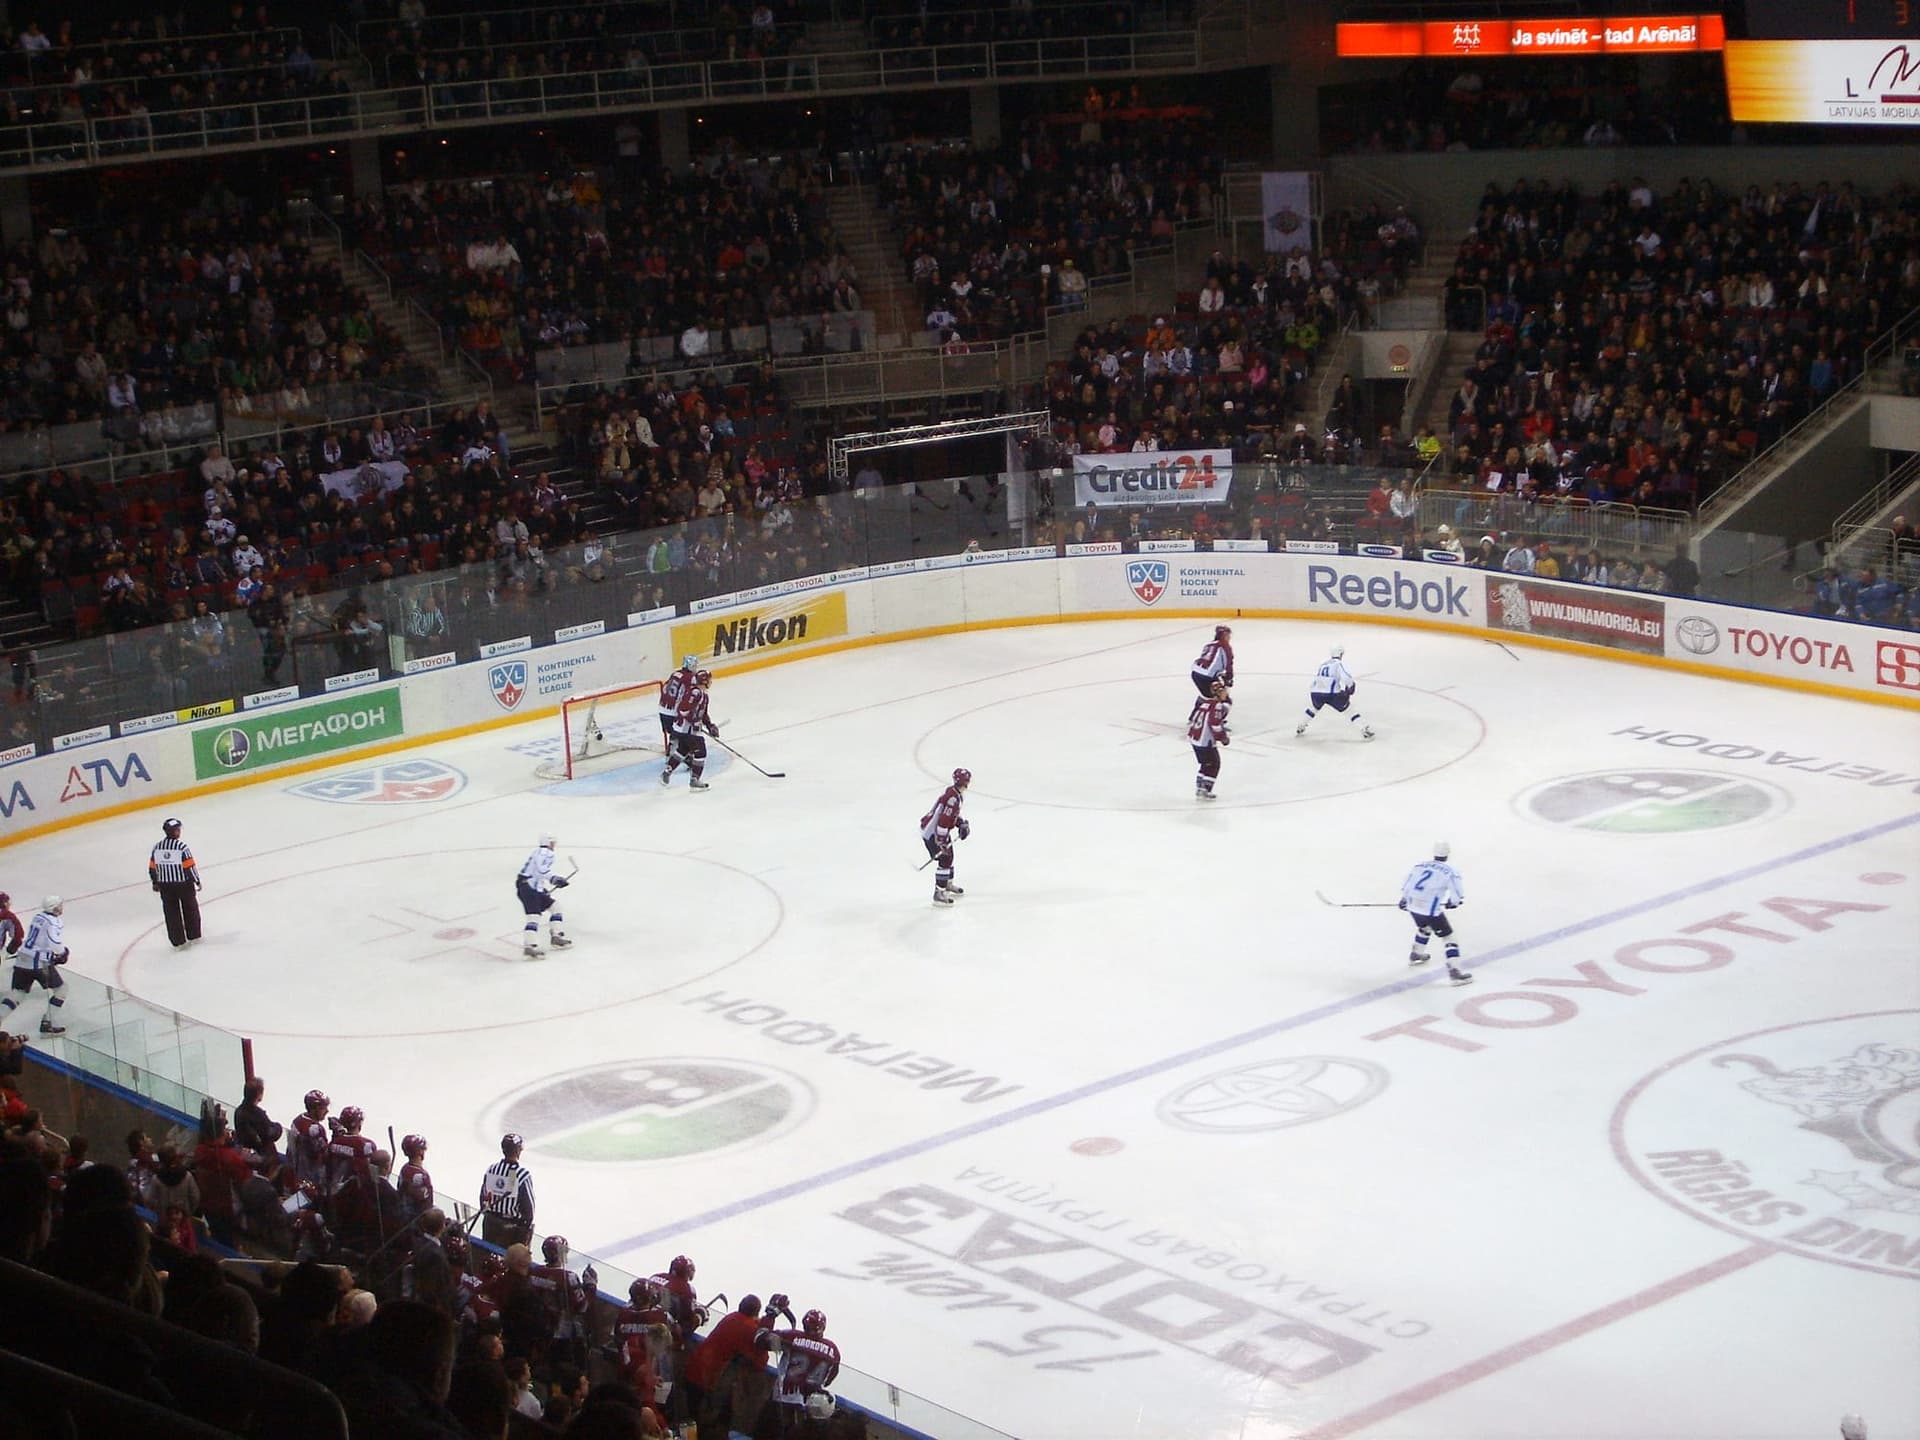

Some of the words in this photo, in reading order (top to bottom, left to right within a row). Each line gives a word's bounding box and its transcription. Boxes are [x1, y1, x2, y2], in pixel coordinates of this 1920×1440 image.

[1512, 29, 1534, 46] Ja
[1536, 27, 1588, 46] svinēt
[1605, 27, 1635, 44] tad
[1638, 22, 1697, 43] Arēnā!
[1828, 107, 1877, 118] LATVIJAS
[1089, 454, 1218, 493] Credit24
[1084, 544, 1118, 553] TOYOTA
[795, 576, 823, 589] TOYOTA
[1179, 568, 1246, 577] KONTINENTAL
[1180, 578, 1220, 587] HOCKEY
[1180, 588, 1218, 597] LEAGUE
[1308, 565, 1471, 618] Reebok
[1530, 598, 1661, 641] WWW.DINAMORIGA.EU
[713, 613, 808, 657] Nikon
[1728, 627, 1855, 673] TOYOTA
[421, 655, 453, 668] TOYOTA
[537, 653, 597, 674] KONTINENTAL
[538, 670, 574, 685] HOCKEY
[539, 681, 573, 695] LEAGUE
[191, 704, 222, 719] Nikon
[0, 747, 32, 762] TOYOTA
[1414, 869, 1433, 890] 2
[1360, 896, 1893, 1055] TOYOTA
[953, 1163, 1129, 1215] ГРУППА
[1645, 1148, 1808, 1227] RĪGAS
[831, 1183, 1384, 1389] СОГАЗ
[1128, 1228, 1432, 1340] СТРАХОВАЯ
[972, 1324, 1161, 1373] 15
